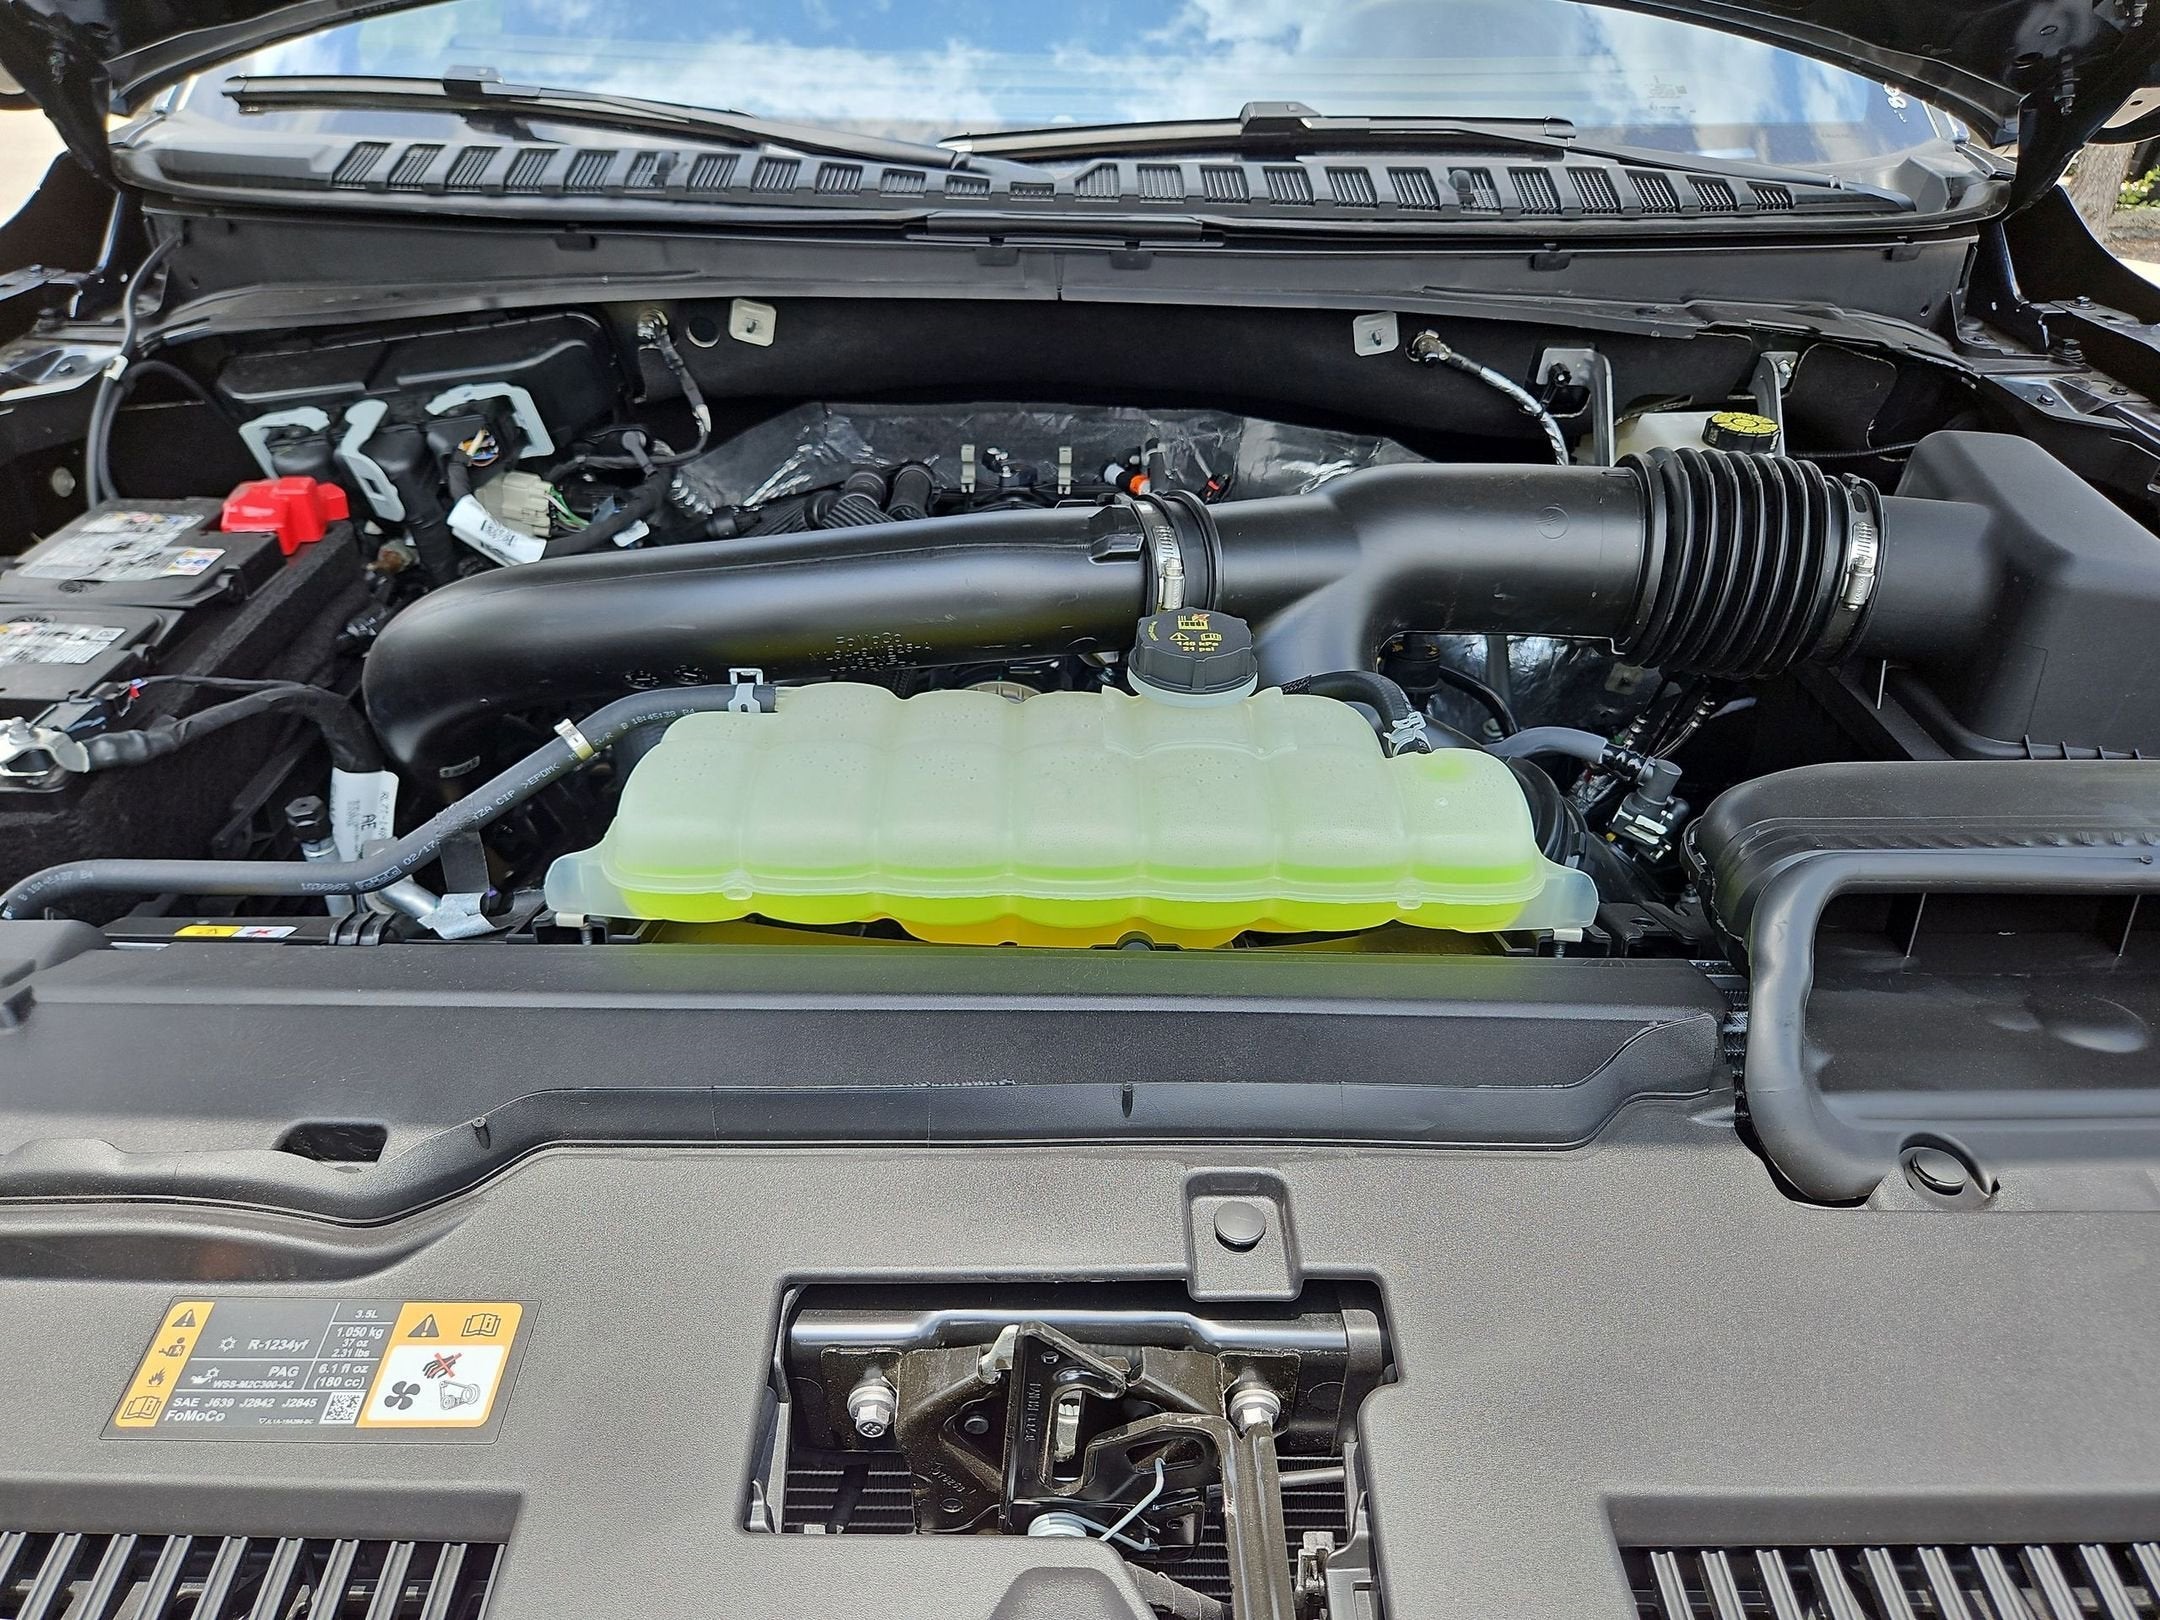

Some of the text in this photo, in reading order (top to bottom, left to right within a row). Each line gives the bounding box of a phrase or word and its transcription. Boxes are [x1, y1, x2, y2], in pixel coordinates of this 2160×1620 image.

[495, 789, 516, 805] CIP
[355, 1310, 378, 1319] 3.5L
[337, 1327, 384, 1339] 1.050 kg
[248, 1338, 310, 1352] R-1234yf
[342, 1339, 353, 1347] 37
[331, 1349, 370, 1357] 2.31 lbs
[268, 1366, 300, 1377] PAG
[318, 1363, 369, 1374] 6.1 fl oz
[313, 1377, 365, 1389] (180 cc)
[172, 1397, 318, 1407] SAE J639 J2842 J2845
[164, 1410, 226, 1422] FoMoCo
